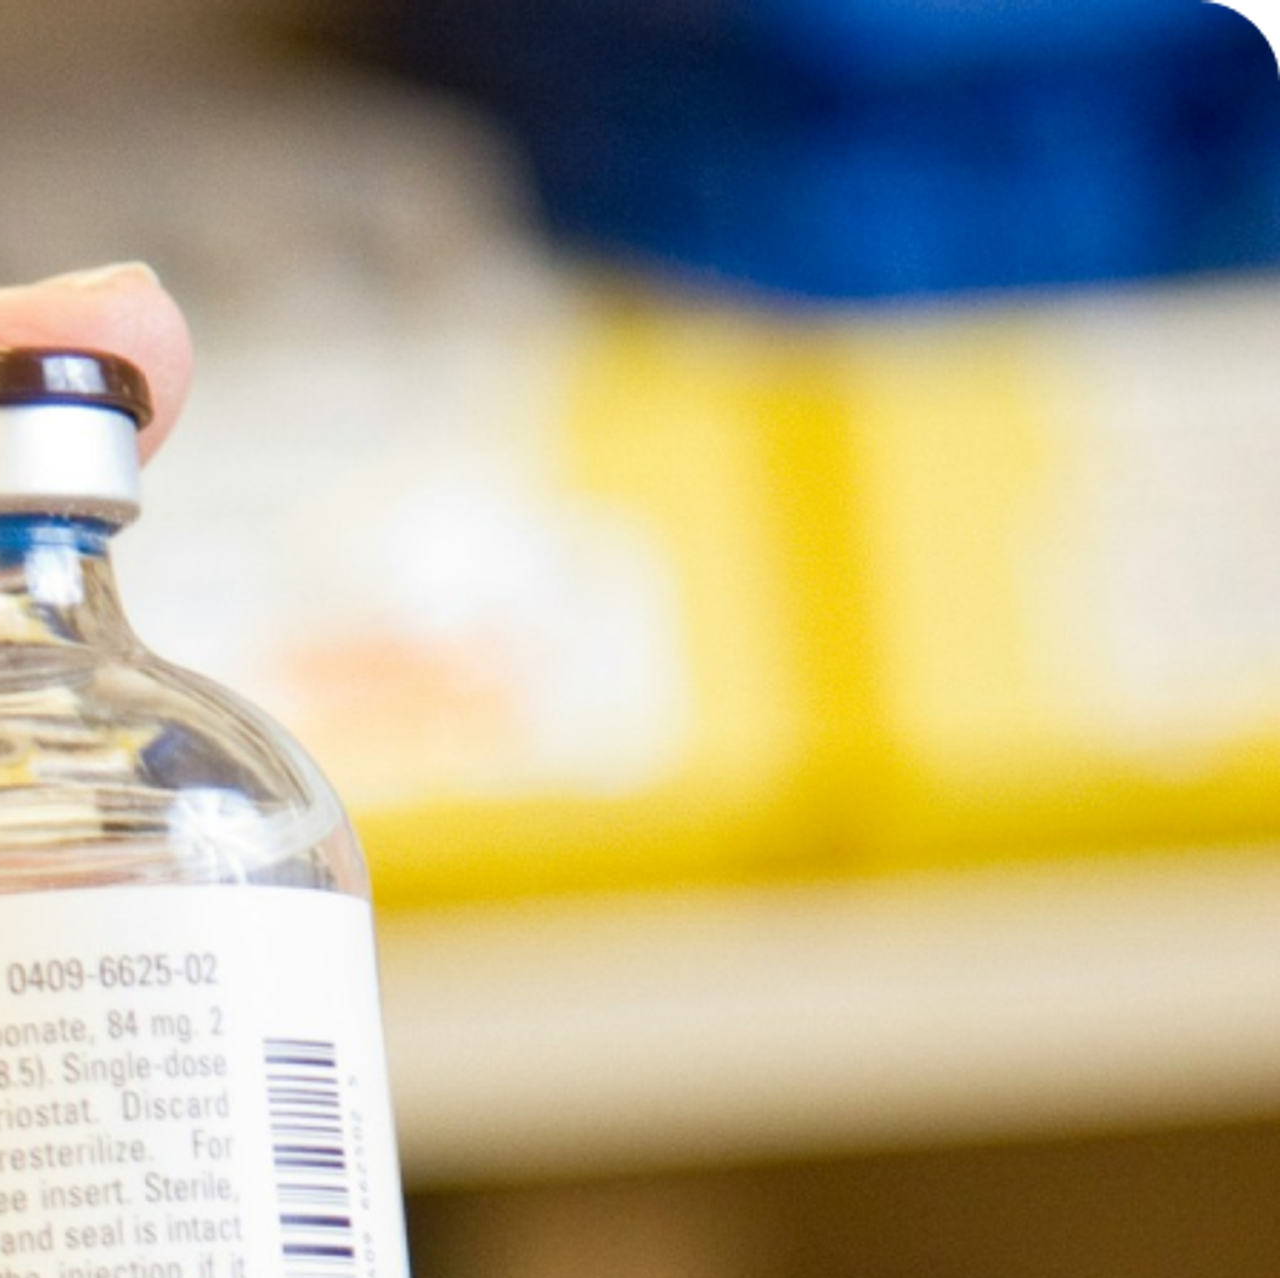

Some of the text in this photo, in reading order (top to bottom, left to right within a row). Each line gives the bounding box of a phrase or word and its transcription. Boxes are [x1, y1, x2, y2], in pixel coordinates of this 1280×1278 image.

[7, 953, 219, 996] 0409-6625-02
[107, 1010, 139, 1041] 84
[209, 1006, 224, 1037] 2
[62, 1050, 228, 1089] Single-dose
[121, 1090, 231, 1123] Discard
[192, 1129, 233, 1161] For
[40, 1179, 131, 1211] insert.
[144, 1172, 241, 1206] Sterile,
[0, 1223, 54, 1256] and
[64, 1220, 124, 1250] seal
[134, 1217, 158, 1246] is
[167, 1213, 243, 1245] intact
